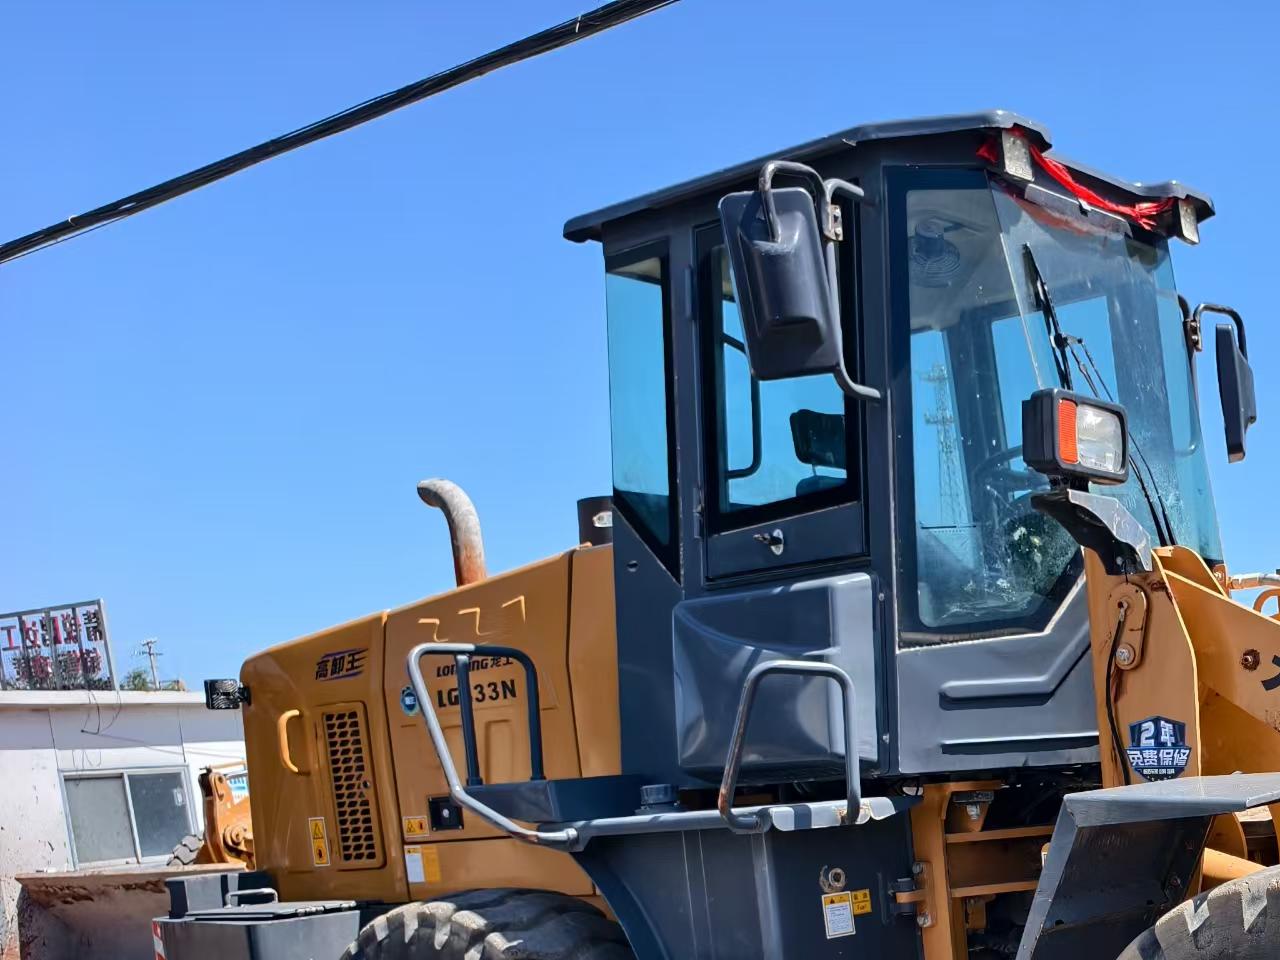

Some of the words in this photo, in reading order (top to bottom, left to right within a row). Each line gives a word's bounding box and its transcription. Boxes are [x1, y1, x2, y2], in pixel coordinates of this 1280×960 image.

[437, 679, 517, 708] LG33N
[1140, 720, 1175, 747] 2年
[1126, 749, 1190, 766] 免费保修
